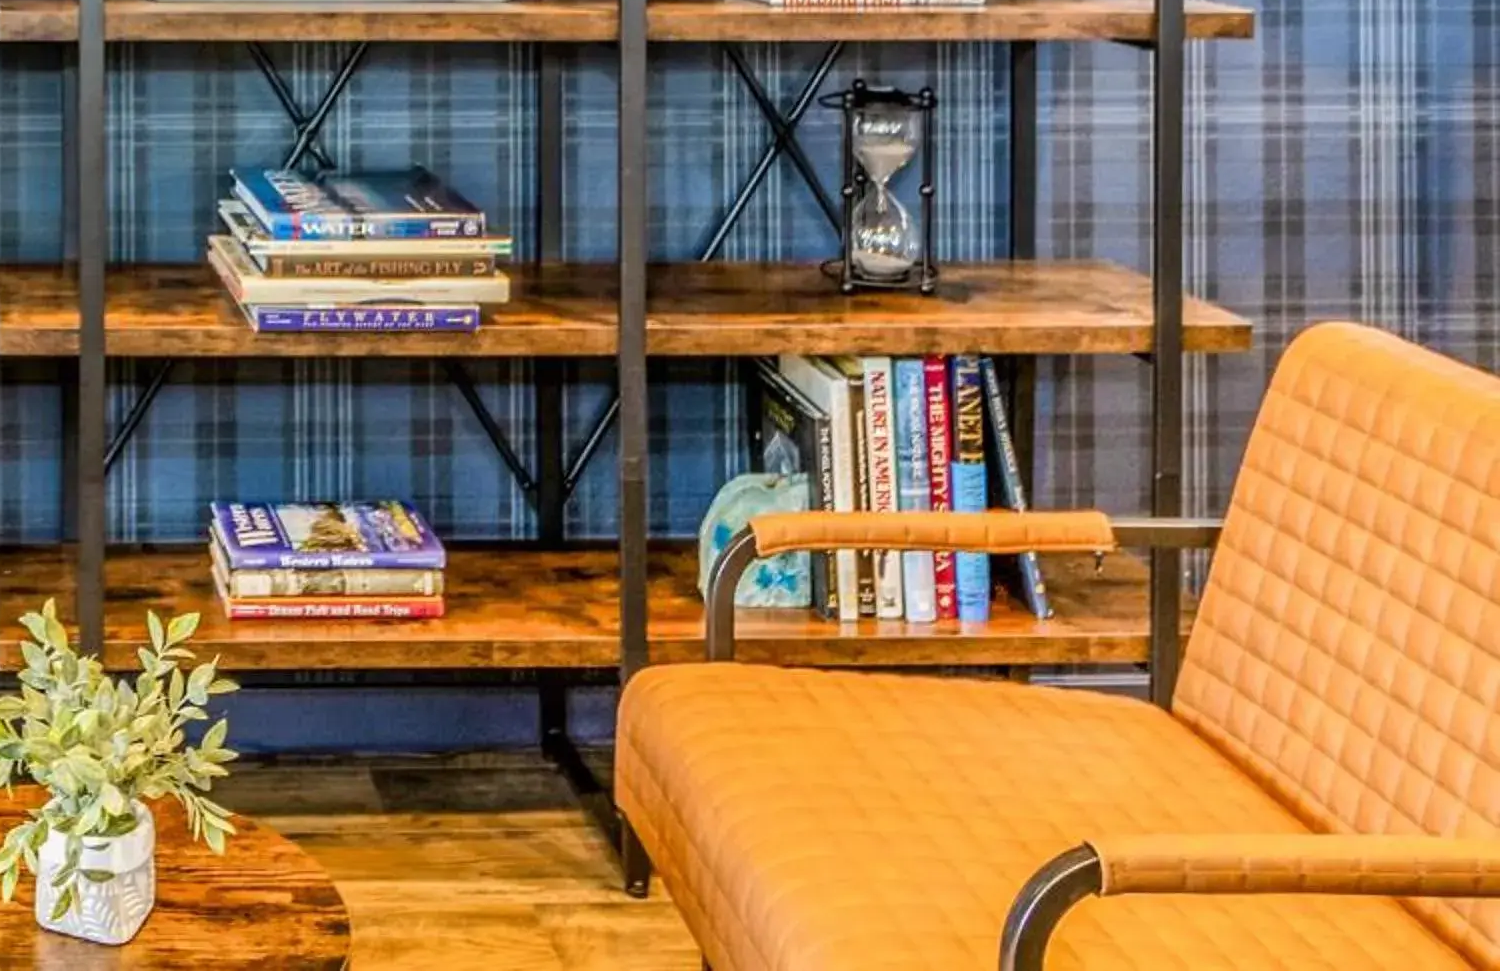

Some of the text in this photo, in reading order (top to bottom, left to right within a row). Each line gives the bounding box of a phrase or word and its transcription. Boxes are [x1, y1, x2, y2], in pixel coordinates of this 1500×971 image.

[302, 219, 377, 235] WATER
[314, 261, 343, 276] ART
[370, 261, 433, 276] FISHING
[435, 261, 463, 275] FLY
[927, 383, 946, 425] THE
[870, 370, 893, 511] NATURE IN AMERIC
[929, 427, 950, 501] MIGHTY
